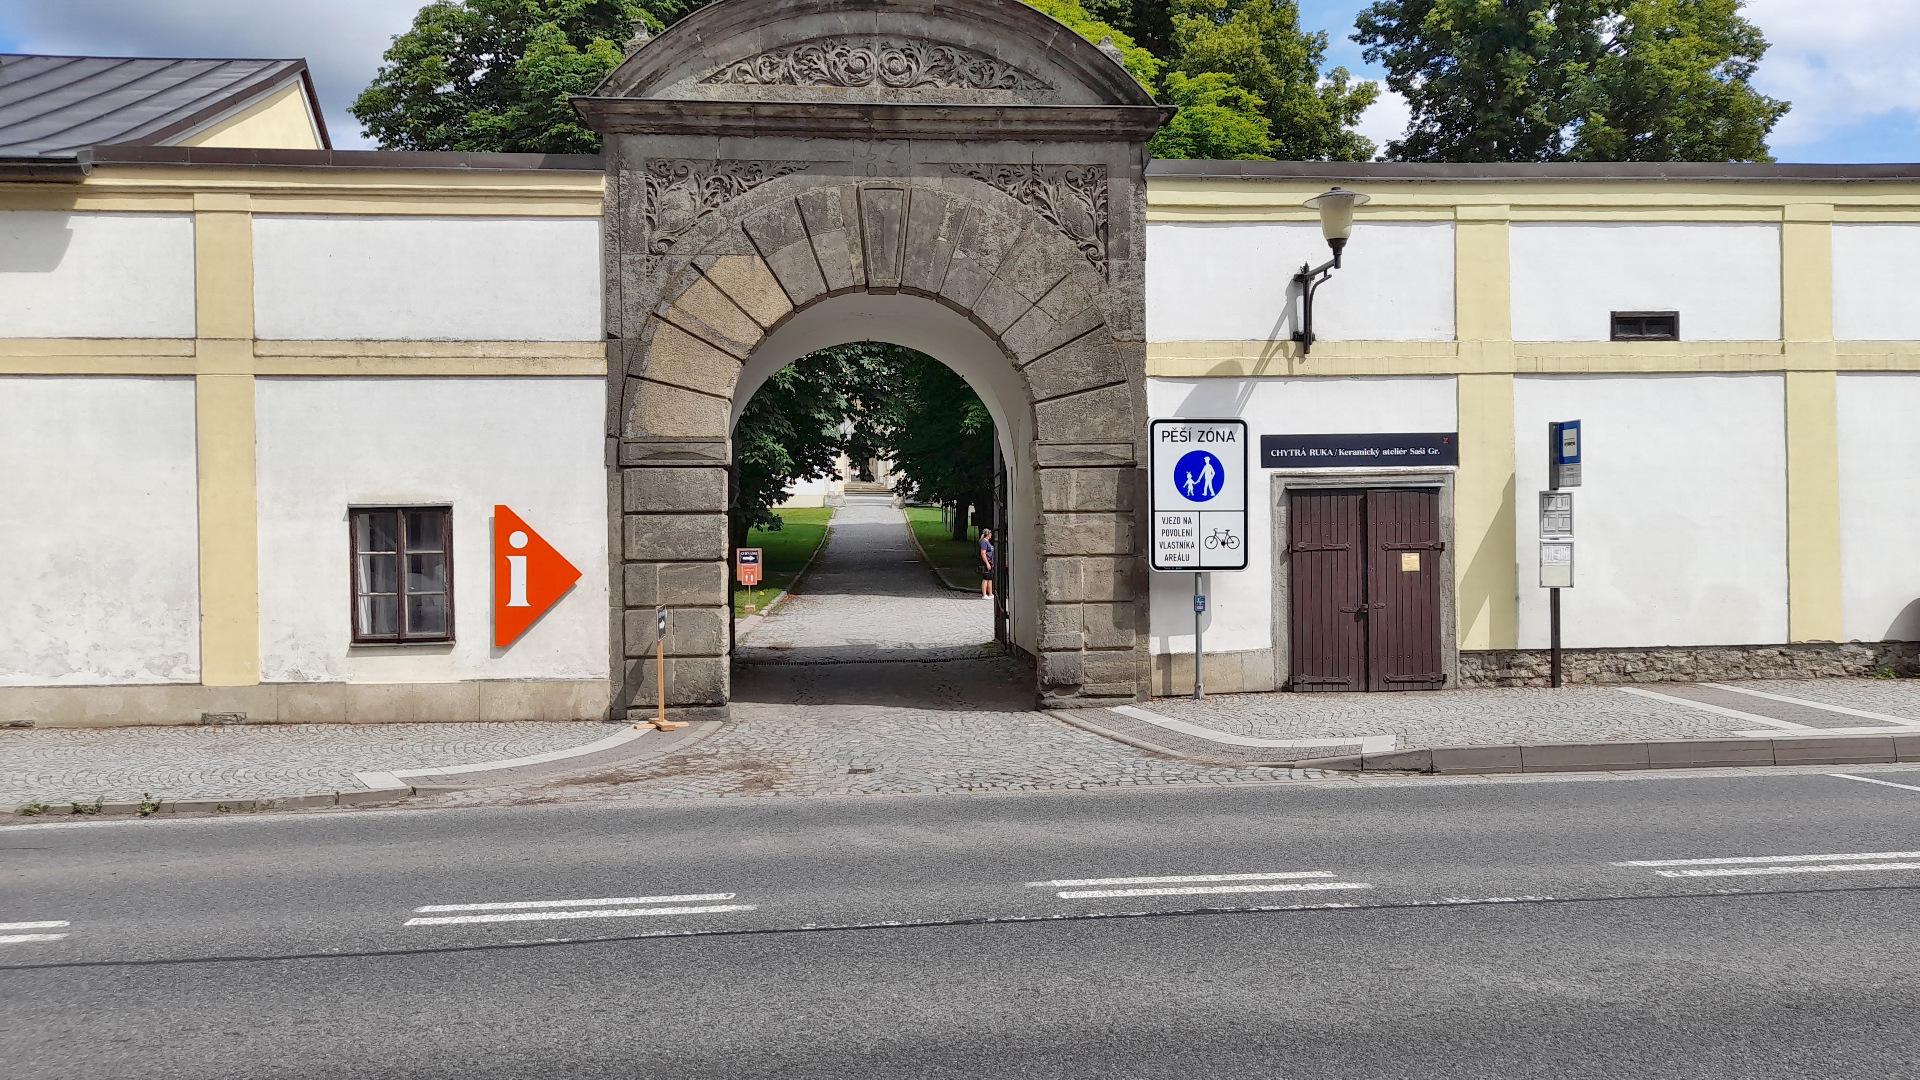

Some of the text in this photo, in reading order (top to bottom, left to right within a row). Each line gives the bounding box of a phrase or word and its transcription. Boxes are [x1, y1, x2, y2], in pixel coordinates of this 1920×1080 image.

[1161, 427, 1235, 442] PĚŠÍ ZÓNA
[1270, 447, 1307, 457] CHYTRÁ
[1427, 446, 1441, 455] Gr.
[1161, 516, 1192, 525] VJEZD NA
[1161, 526, 1193, 537] POVOLENÍ
[1158, 539, 1195, 549] VLASTNÍKA
[1164, 551, 1190, 562] AREÁLU
[505, 530, 532, 607] i
